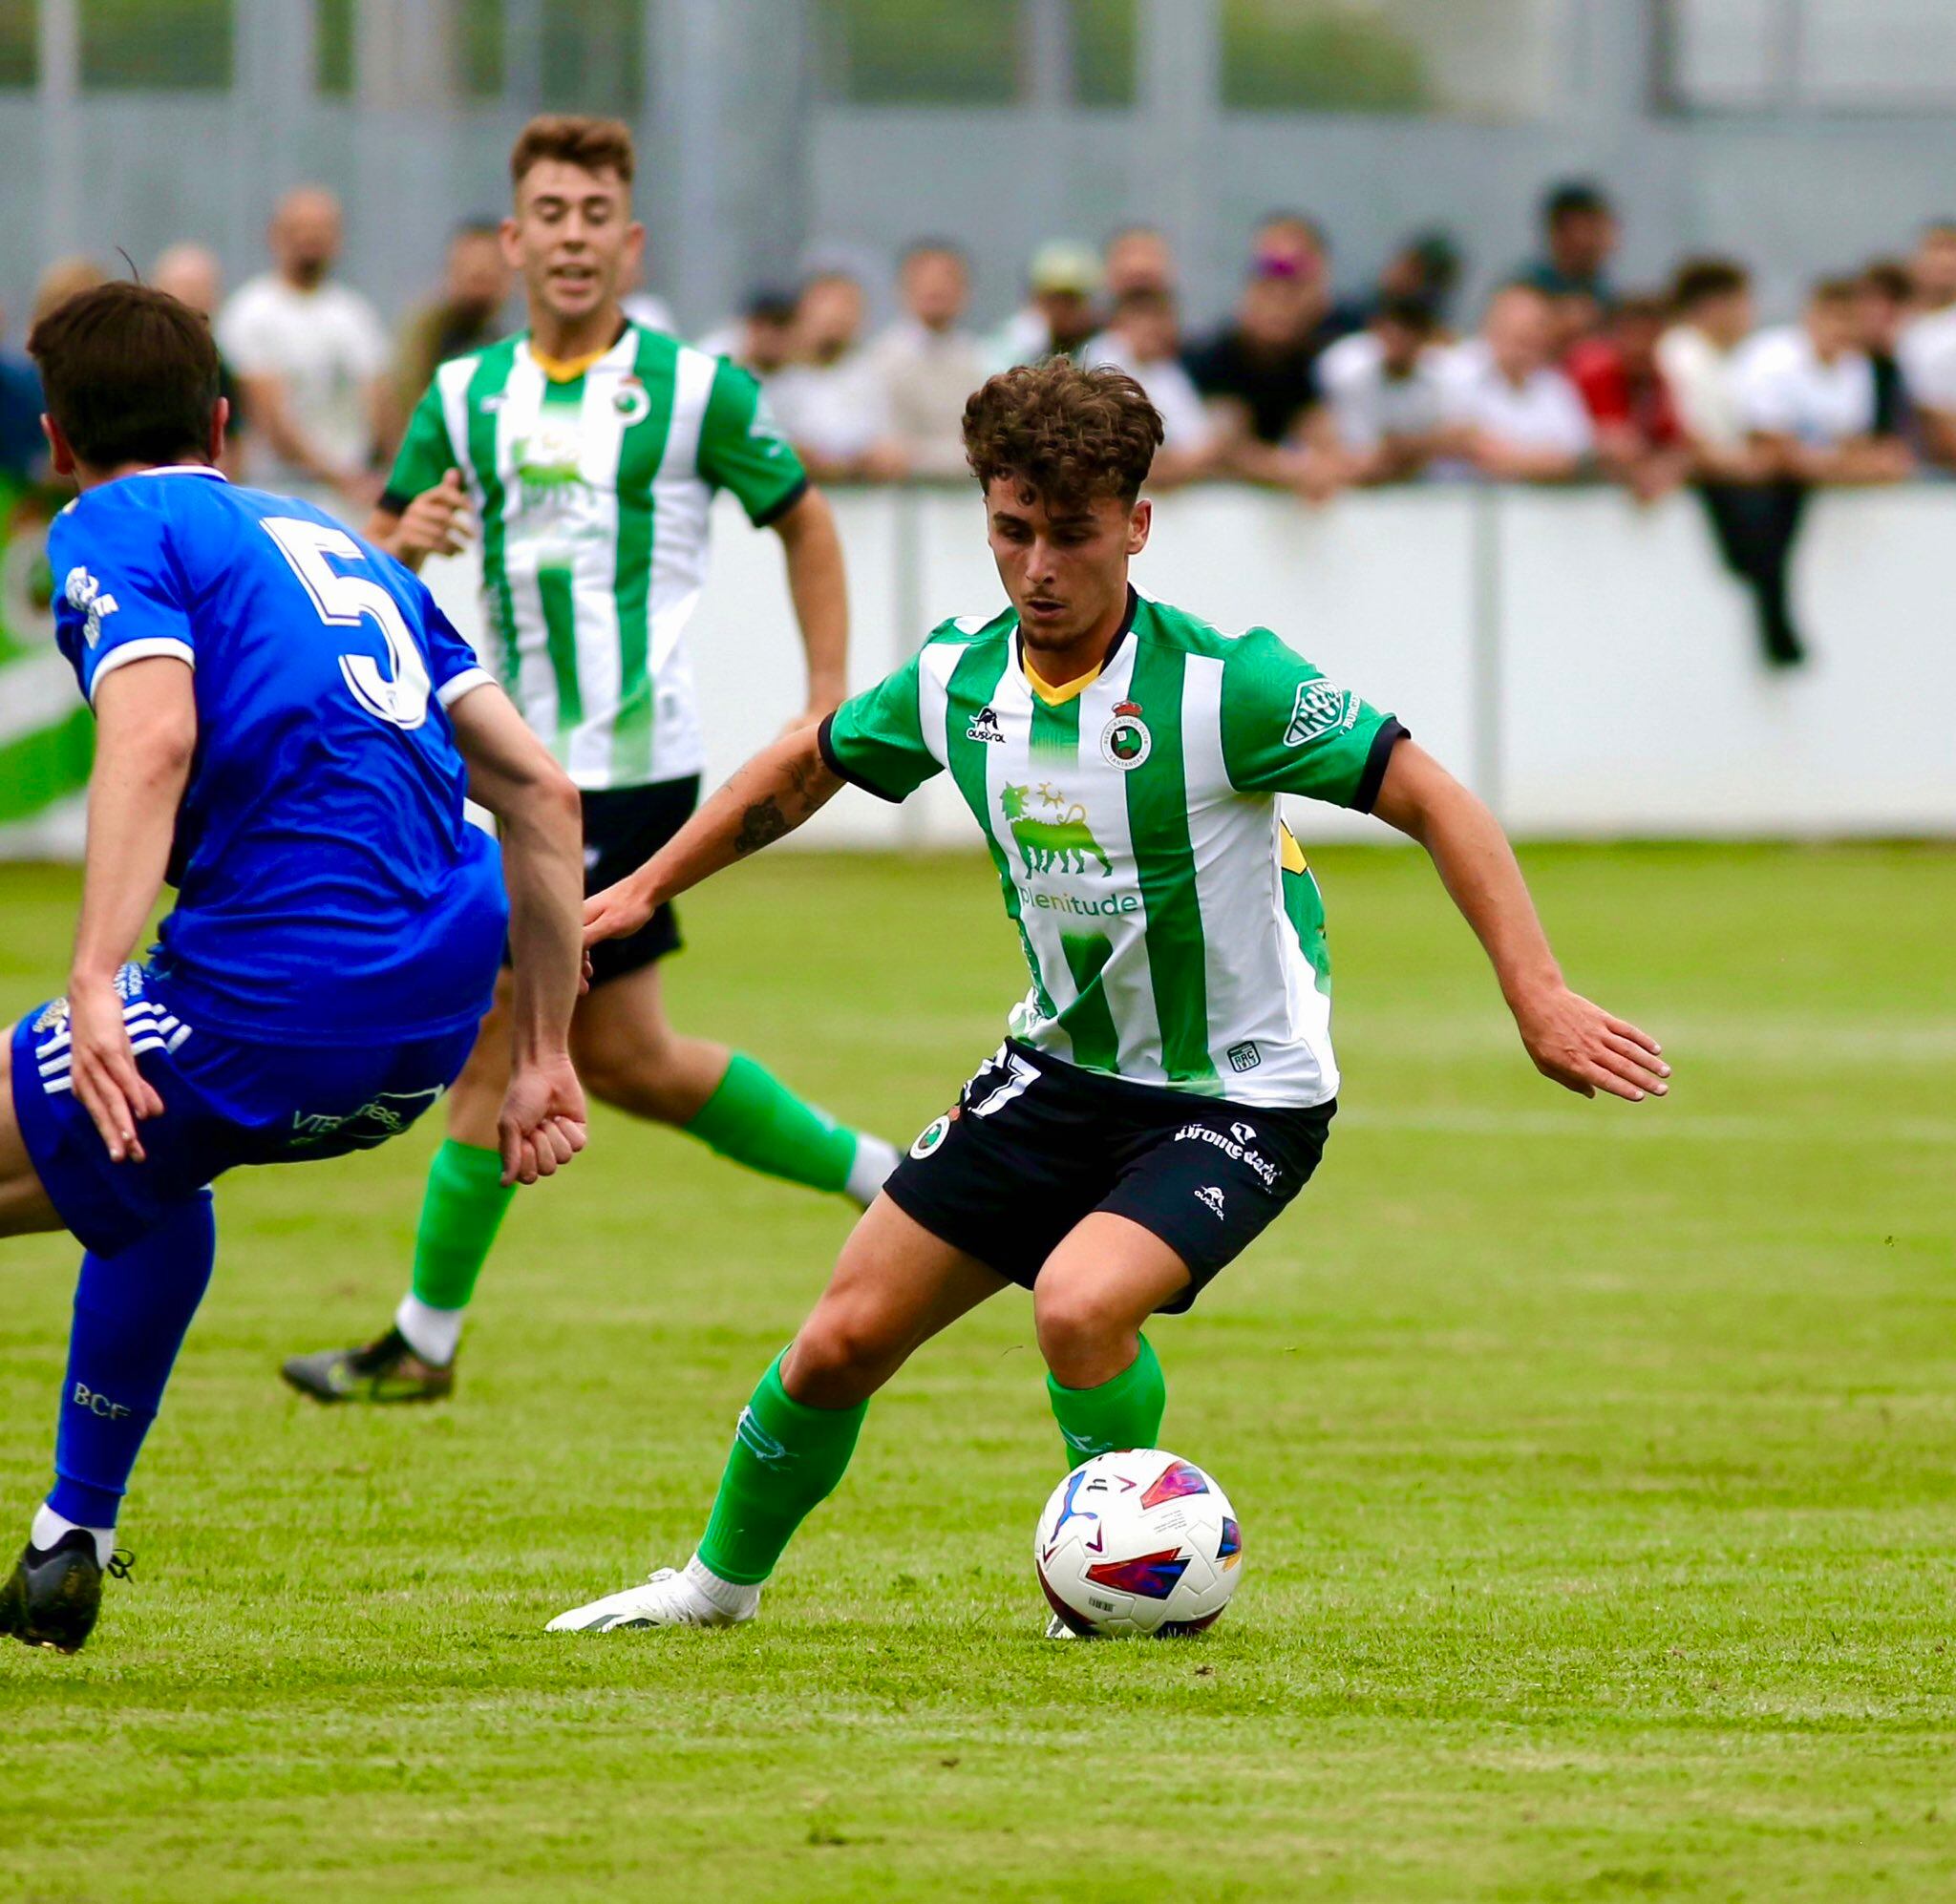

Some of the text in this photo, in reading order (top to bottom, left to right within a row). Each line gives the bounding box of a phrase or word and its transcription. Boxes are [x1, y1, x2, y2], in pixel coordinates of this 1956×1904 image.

[259, 517, 431, 730] 5
[1018, 886, 1138, 916] plenitude
[73, 1382, 132, 1421] BCF
